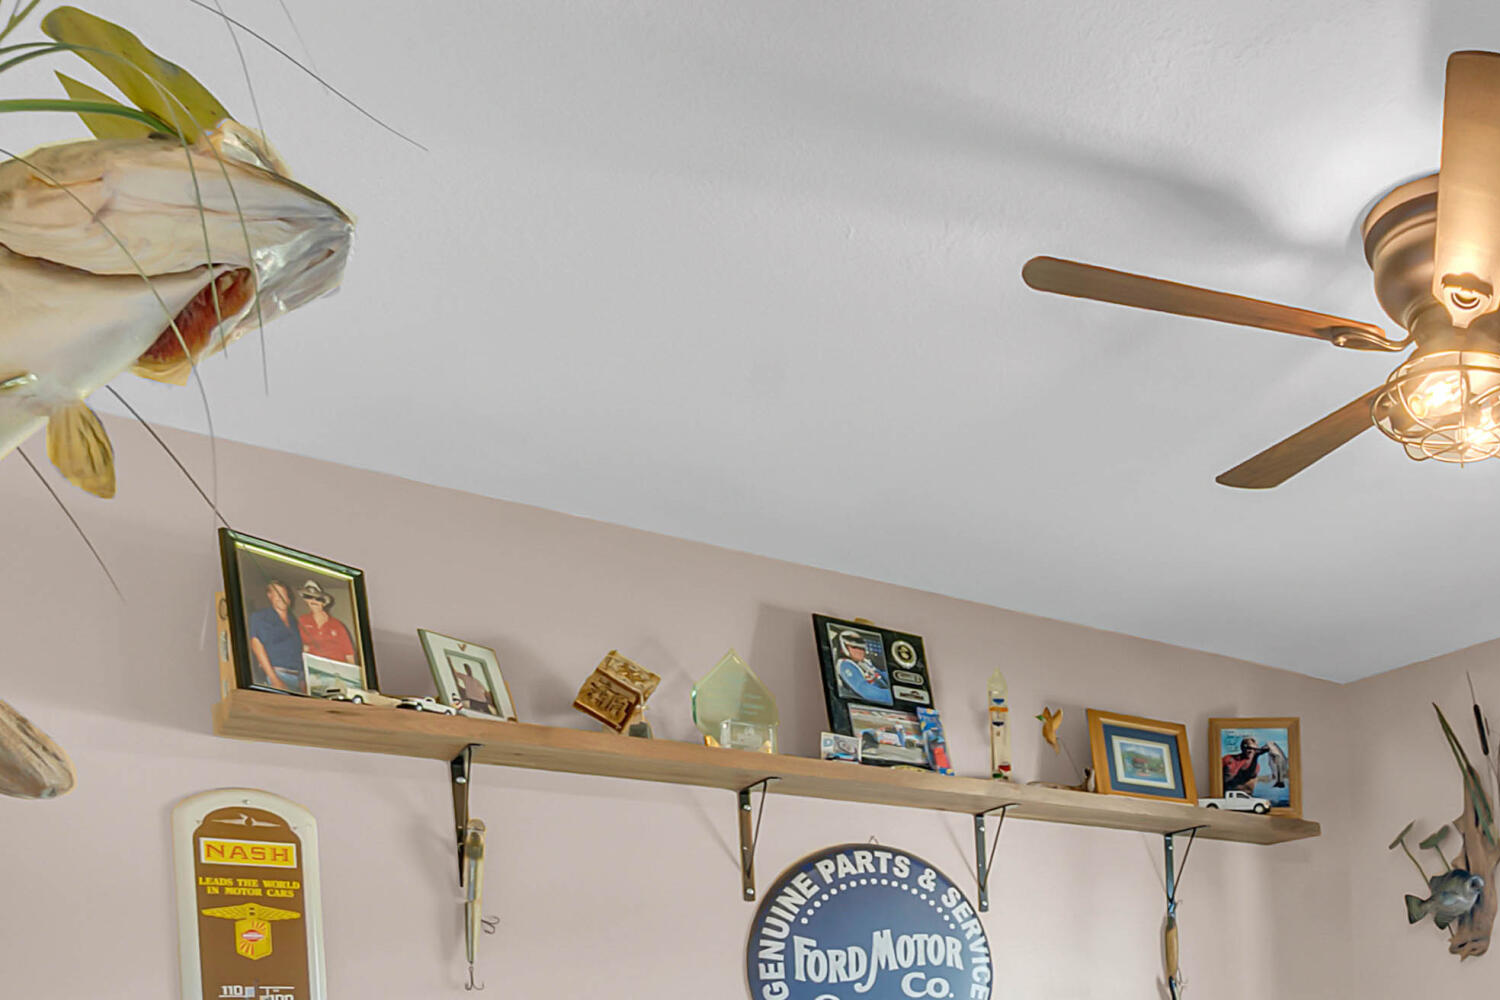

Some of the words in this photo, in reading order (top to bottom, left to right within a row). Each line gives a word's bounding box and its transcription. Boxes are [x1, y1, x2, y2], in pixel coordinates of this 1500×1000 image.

[206, 843, 289, 862] NASH
[815, 850, 911, 884] PARTS
[917, 868, 937, 892] &
[198, 876, 233, 886] LEADS
[236, 878, 259, 888] THE
[262, 879, 300, 890] WORLD
[207, 885, 219, 895] IN
[224, 886, 262, 897] MOTOR
[266, 888, 295, 898] CARS
[793, 935, 868, 984] FORD
[854, 929, 964, 993] MOTOR
[221, 985, 243, 996] 110
